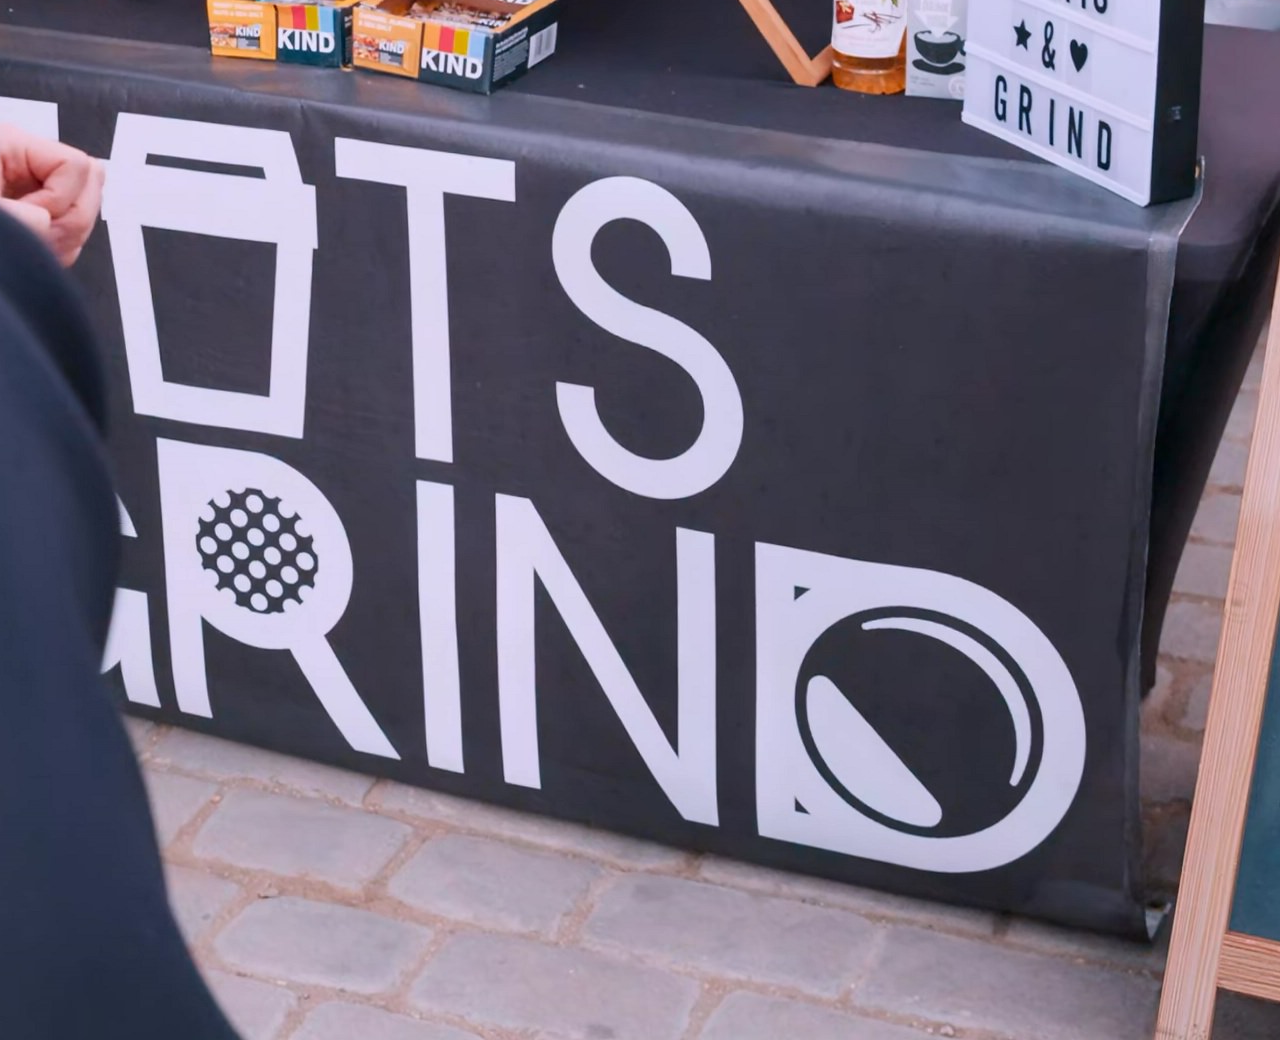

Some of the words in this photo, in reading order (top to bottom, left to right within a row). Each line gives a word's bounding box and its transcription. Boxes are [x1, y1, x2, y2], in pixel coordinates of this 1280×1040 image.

[235, 24, 261, 37] KIND
[278, 27, 335, 53] KIND
[378, 40, 405, 54] KIND
[1041, 20, 1056, 71] &
[421, 47, 483, 79] KIND
[994, 75, 1113, 172] GRIND
